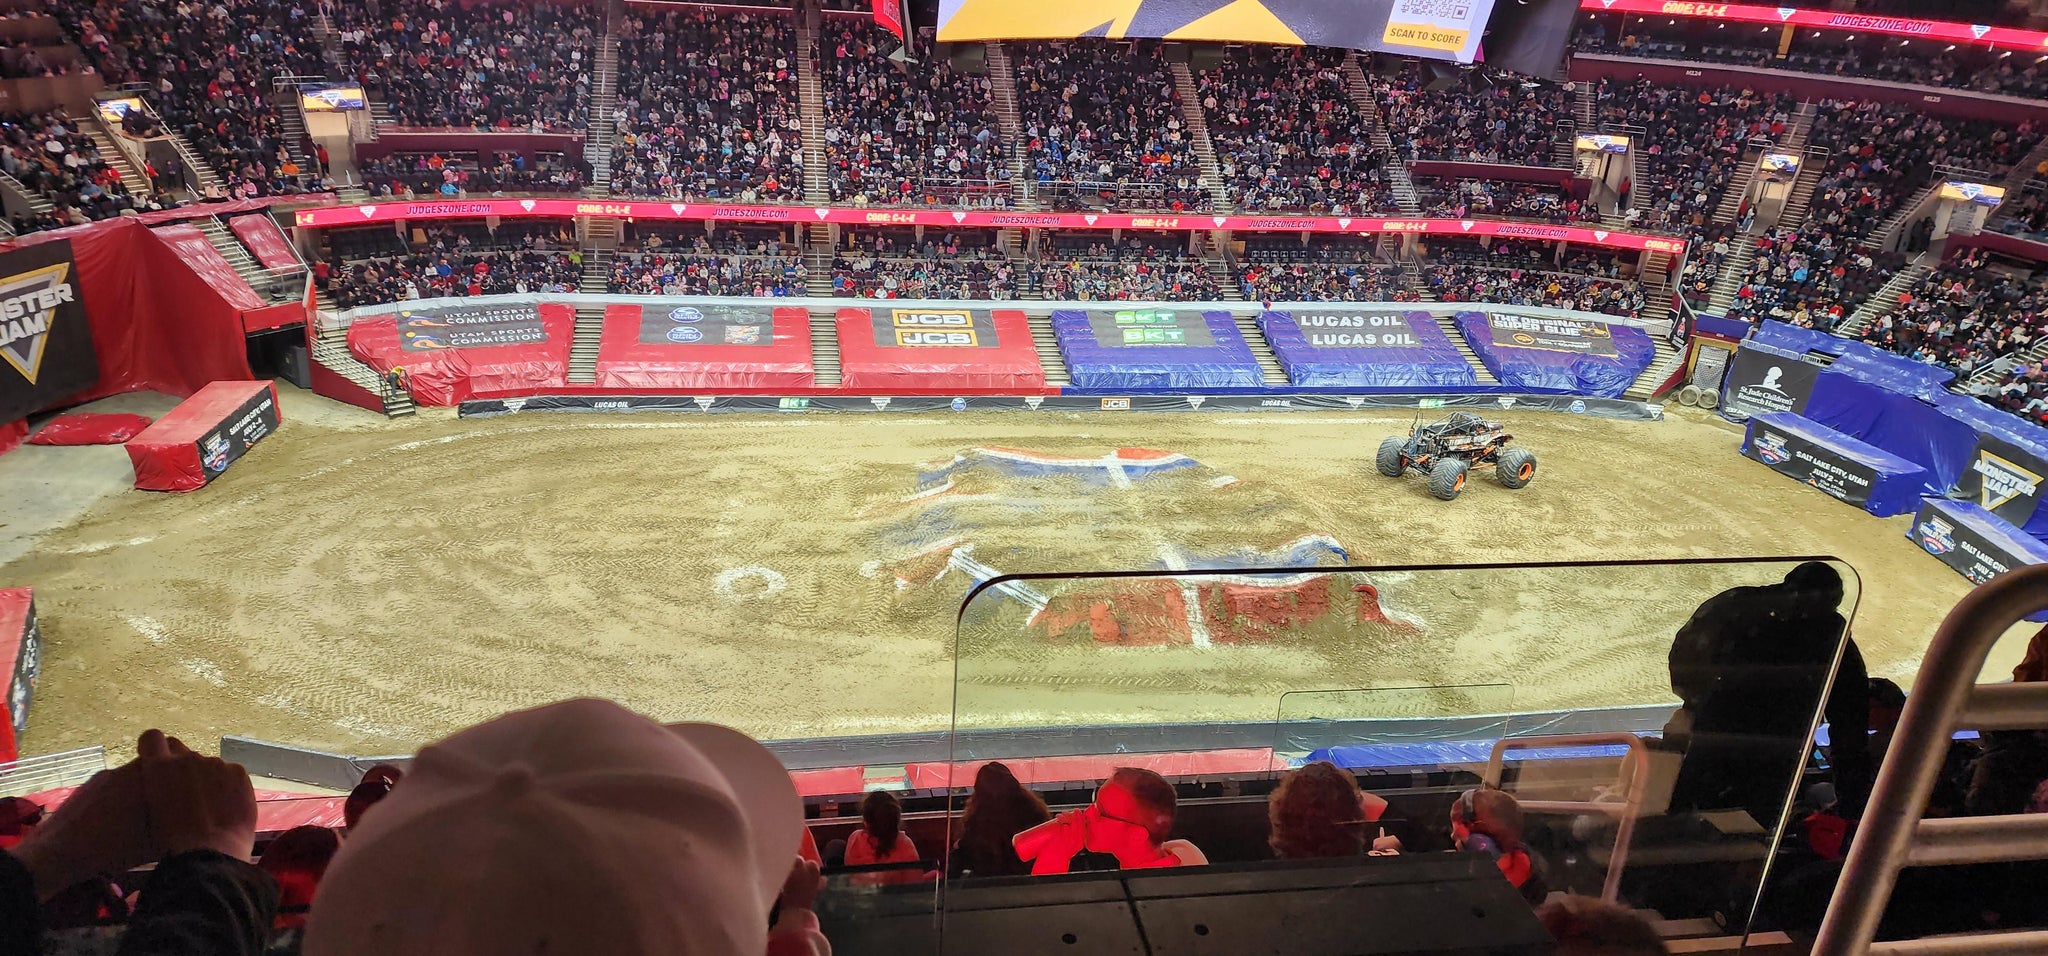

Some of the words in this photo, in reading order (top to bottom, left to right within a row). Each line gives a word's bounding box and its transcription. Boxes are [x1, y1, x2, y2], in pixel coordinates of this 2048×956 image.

[1662, 2, 1696, 16] CODE:
[1696, 4, 1728, 16] C-L-E
[1828, 15, 1932, 33] JUDGESZONE.COM
[1390, 28, 1416, 39] SCAN
[1417, 31, 1428, 40] TO
[1430, 32, 1462, 45] SCORE
[406, 204, 490, 215] JUDGESZONE.COM
[577, 204, 604, 214] CODE:
[605, 205, 632, 214] C-L-E
[713, 208, 788, 218] JUDGESZONE.COM
[866, 212, 890, 222] CODE:
[892, 214, 916, 222] C-L-E
[990, 216, 1061, 224] JUDGESZONE.COM
[1132, 218, 1155, 227] CODE:
[1156, 219, 1178, 227] C-L-E
[1248, 220, 1316, 228] JUDGESZONE.COM
[1383, 222, 1405, 230] CODE:
[1406, 222, 1428, 230] C-L-E
[1496, 226, 1568, 238] JUDGESZONE.COM
[1645, 240, 1671, 249] CODE:
[0, 283, 75, 322] STER
[486, 308, 534, 316] SPORTS
[1116, 312, 1174, 322] BKT
[446, 313, 537, 324] COMMISSION
[899, 314, 967, 324] JCB
[1301, 316, 1364, 327] LUCAS
[1370, 316, 1403, 326] OIL
[1492, 313, 1518, 324] THE
[1518, 316, 1583, 329] ORIGINAL
[490, 328, 540, 336] SPORTS
[1494, 321, 1541, 332] SUPER
[1545, 326, 1581, 337] GLUE
[451, 334, 542, 346] COMMISSION
[902, 333, 971, 344] JCB
[1124, 330, 1183, 341] BKT
[1312, 334, 1377, 345] LUCAS
[1382, 334, 1416, 345] OIL
[1738, 393, 1765, 406] Research
[1765, 400, 1792, 412] Hospital
[1748, 388, 1763, 398] Jude
[1763, 392, 1794, 406] Children's
[1104, 400, 1128, 408] JCB
[1796, 450, 1813, 462] SALT
[1813, 458, 1831, 470] LAKE
[1831, 464, 1848, 479] CITY,
[1848, 474, 1869, 487] UTAH
[1812, 468, 1828, 480] JULY
[1973, 459, 2036, 497] MONSTER
[1986, 478, 2014, 499] JAM
[1960, 541, 1976, 555] SALT
[1976, 550, 1994, 567] LAKE
[1974, 562, 1988, 576] JULY
